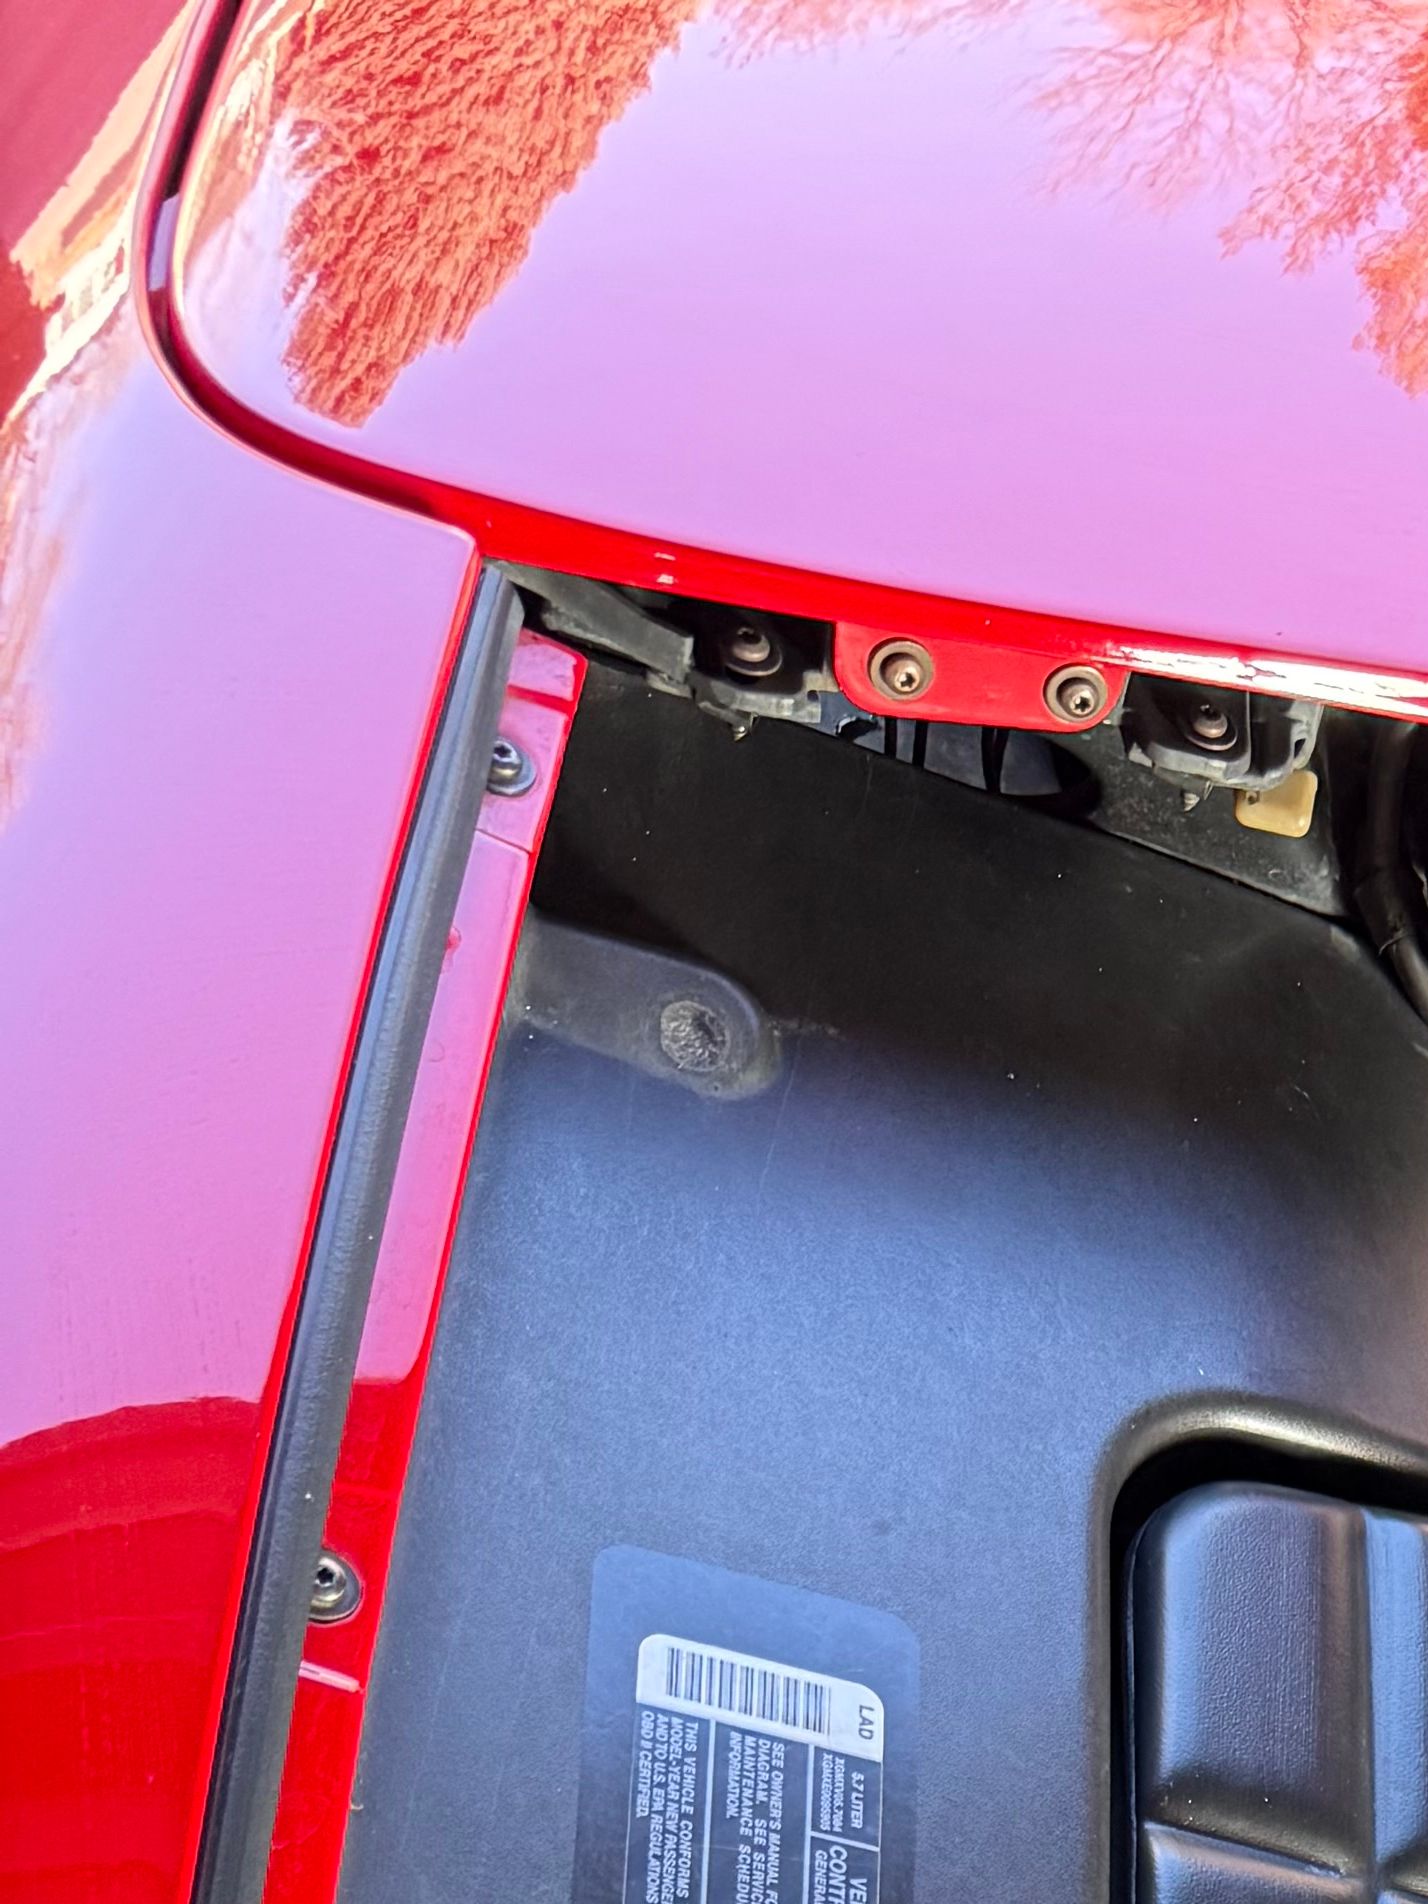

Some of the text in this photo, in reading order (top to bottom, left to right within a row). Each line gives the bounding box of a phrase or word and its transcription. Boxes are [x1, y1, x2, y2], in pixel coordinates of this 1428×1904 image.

[640, 1709, 655, 1739] OBD
[655, 1712, 670, 1744] AND
[684, 1719, 699, 1753] THIS
[858, 1704, 875, 1741] LAD
[652, 1760, 667, 1787] U.S.
[654, 1741, 668, 1761] TO
[666, 1715, 685, 1801] MODEL-YEAR
[725, 1730, 744, 1821] INFORMATION.
[755, 1738, 772, 1806] DIAGRAM.
[772, 1741, 786, 1769] SEE
[635, 1748, 653, 1820] CERTIFIED.
[651, 1786, 666, 1813] EPA
[681, 1754, 697, 1815] VEHICLE
[739, 1734, 758, 1837] MAINTENANCE
[769, 1769, 784, 1830] OWNER'S
[850, 1771, 865, 1829] 5.7 LITER
[665, 1801, 680, 1833] NEW
[754, 1817, 768, 1847] SEE
[645, 1812, 665, 1904] REGULATIONS
[676, 1818, 694, 1899] CONFORMS
[766, 1832, 781, 1887] MANUAL
